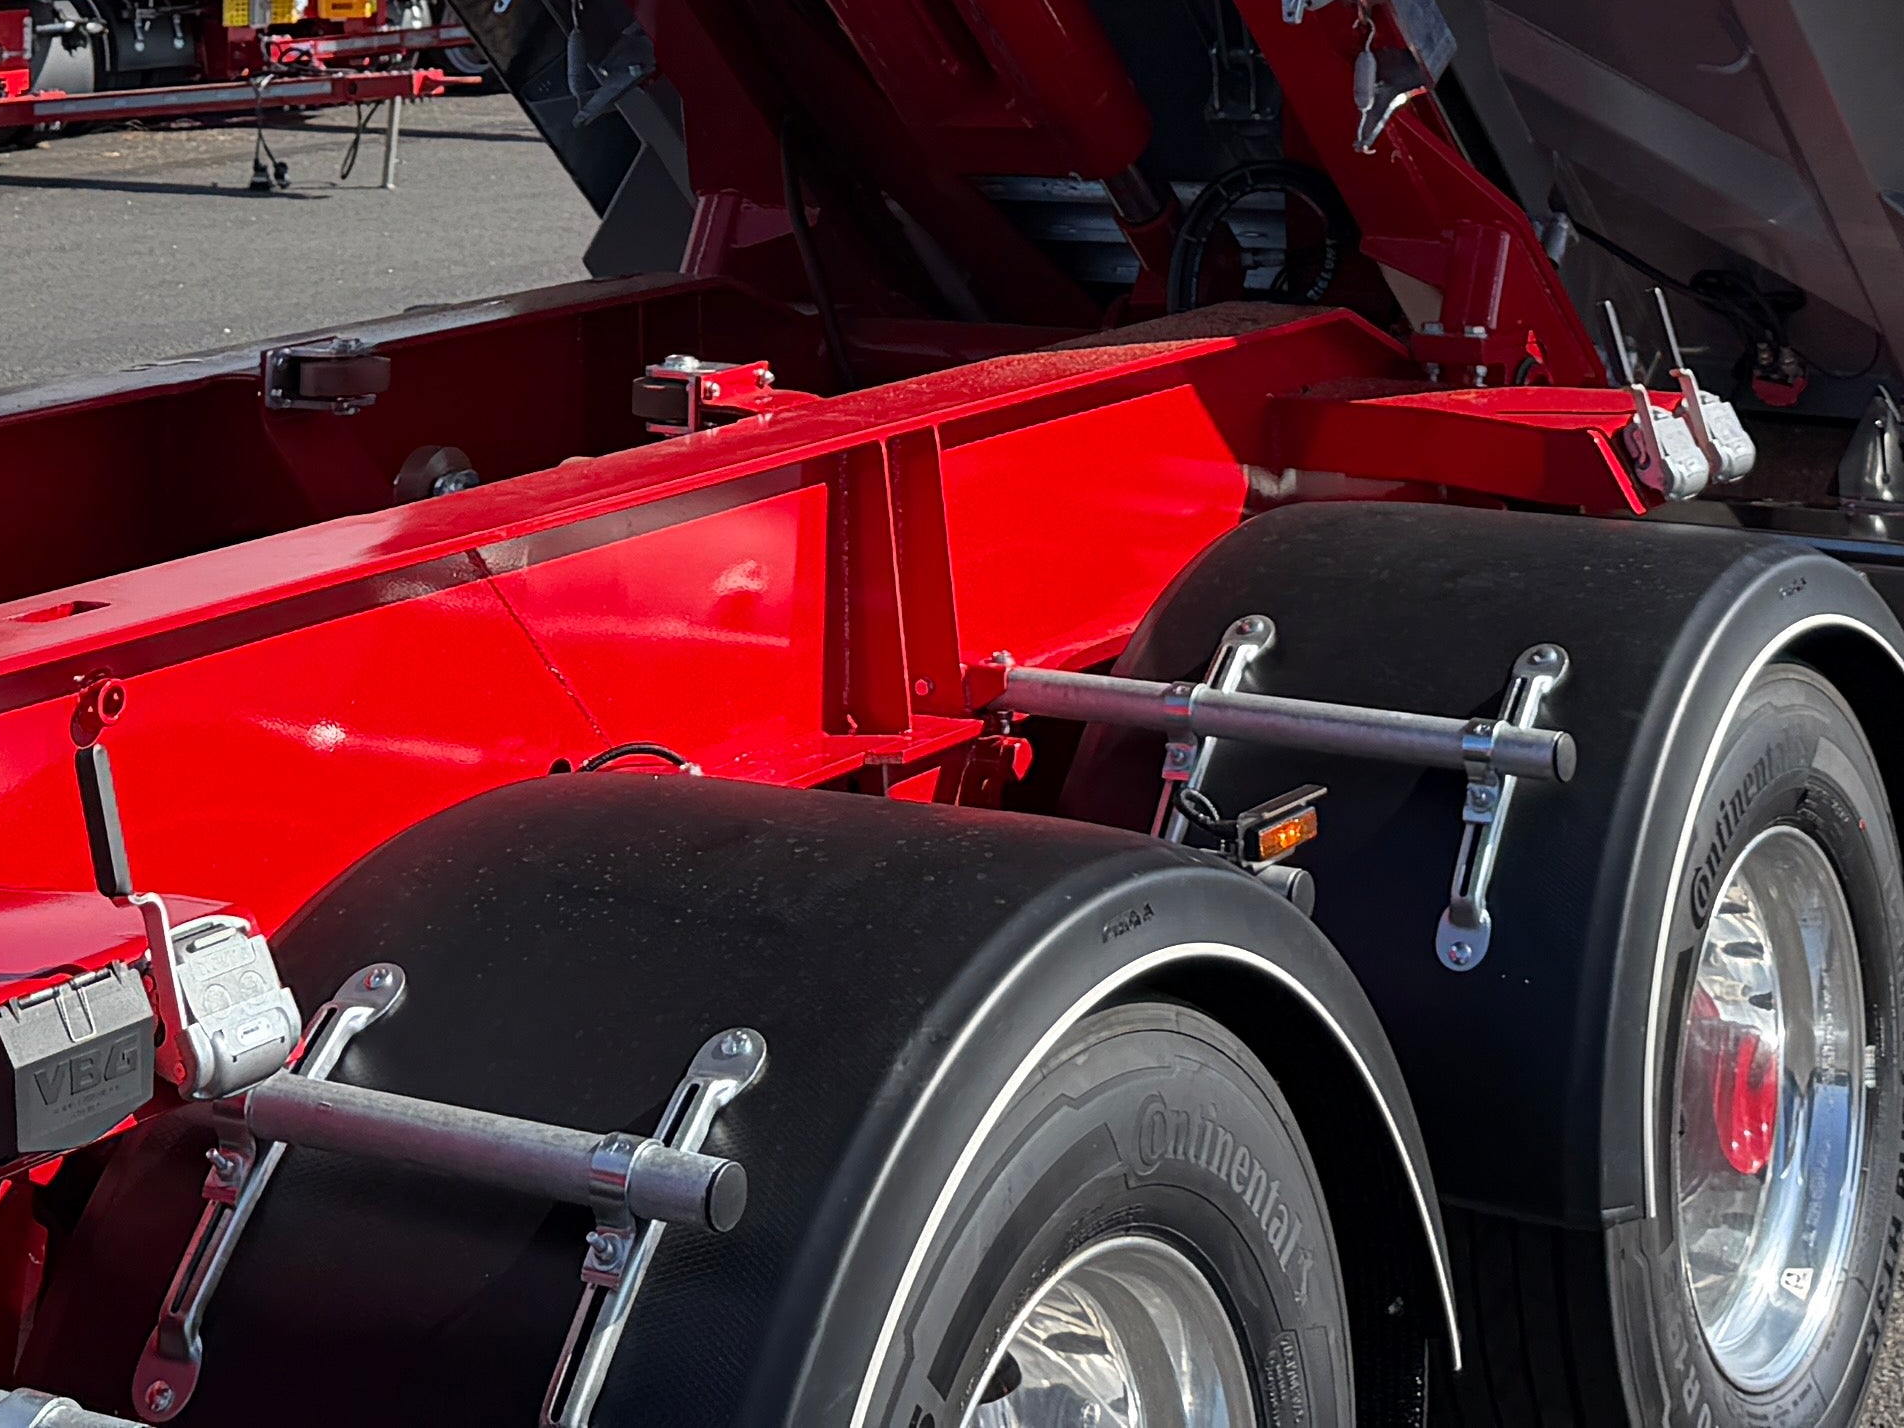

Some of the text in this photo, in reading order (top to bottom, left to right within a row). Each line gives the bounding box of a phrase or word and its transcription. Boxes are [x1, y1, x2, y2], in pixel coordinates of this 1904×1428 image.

[1690, 727, 1794, 930] Continental
[33, 1030, 140, 1106] VBG
[1134, 1090, 1303, 1273] Continental
